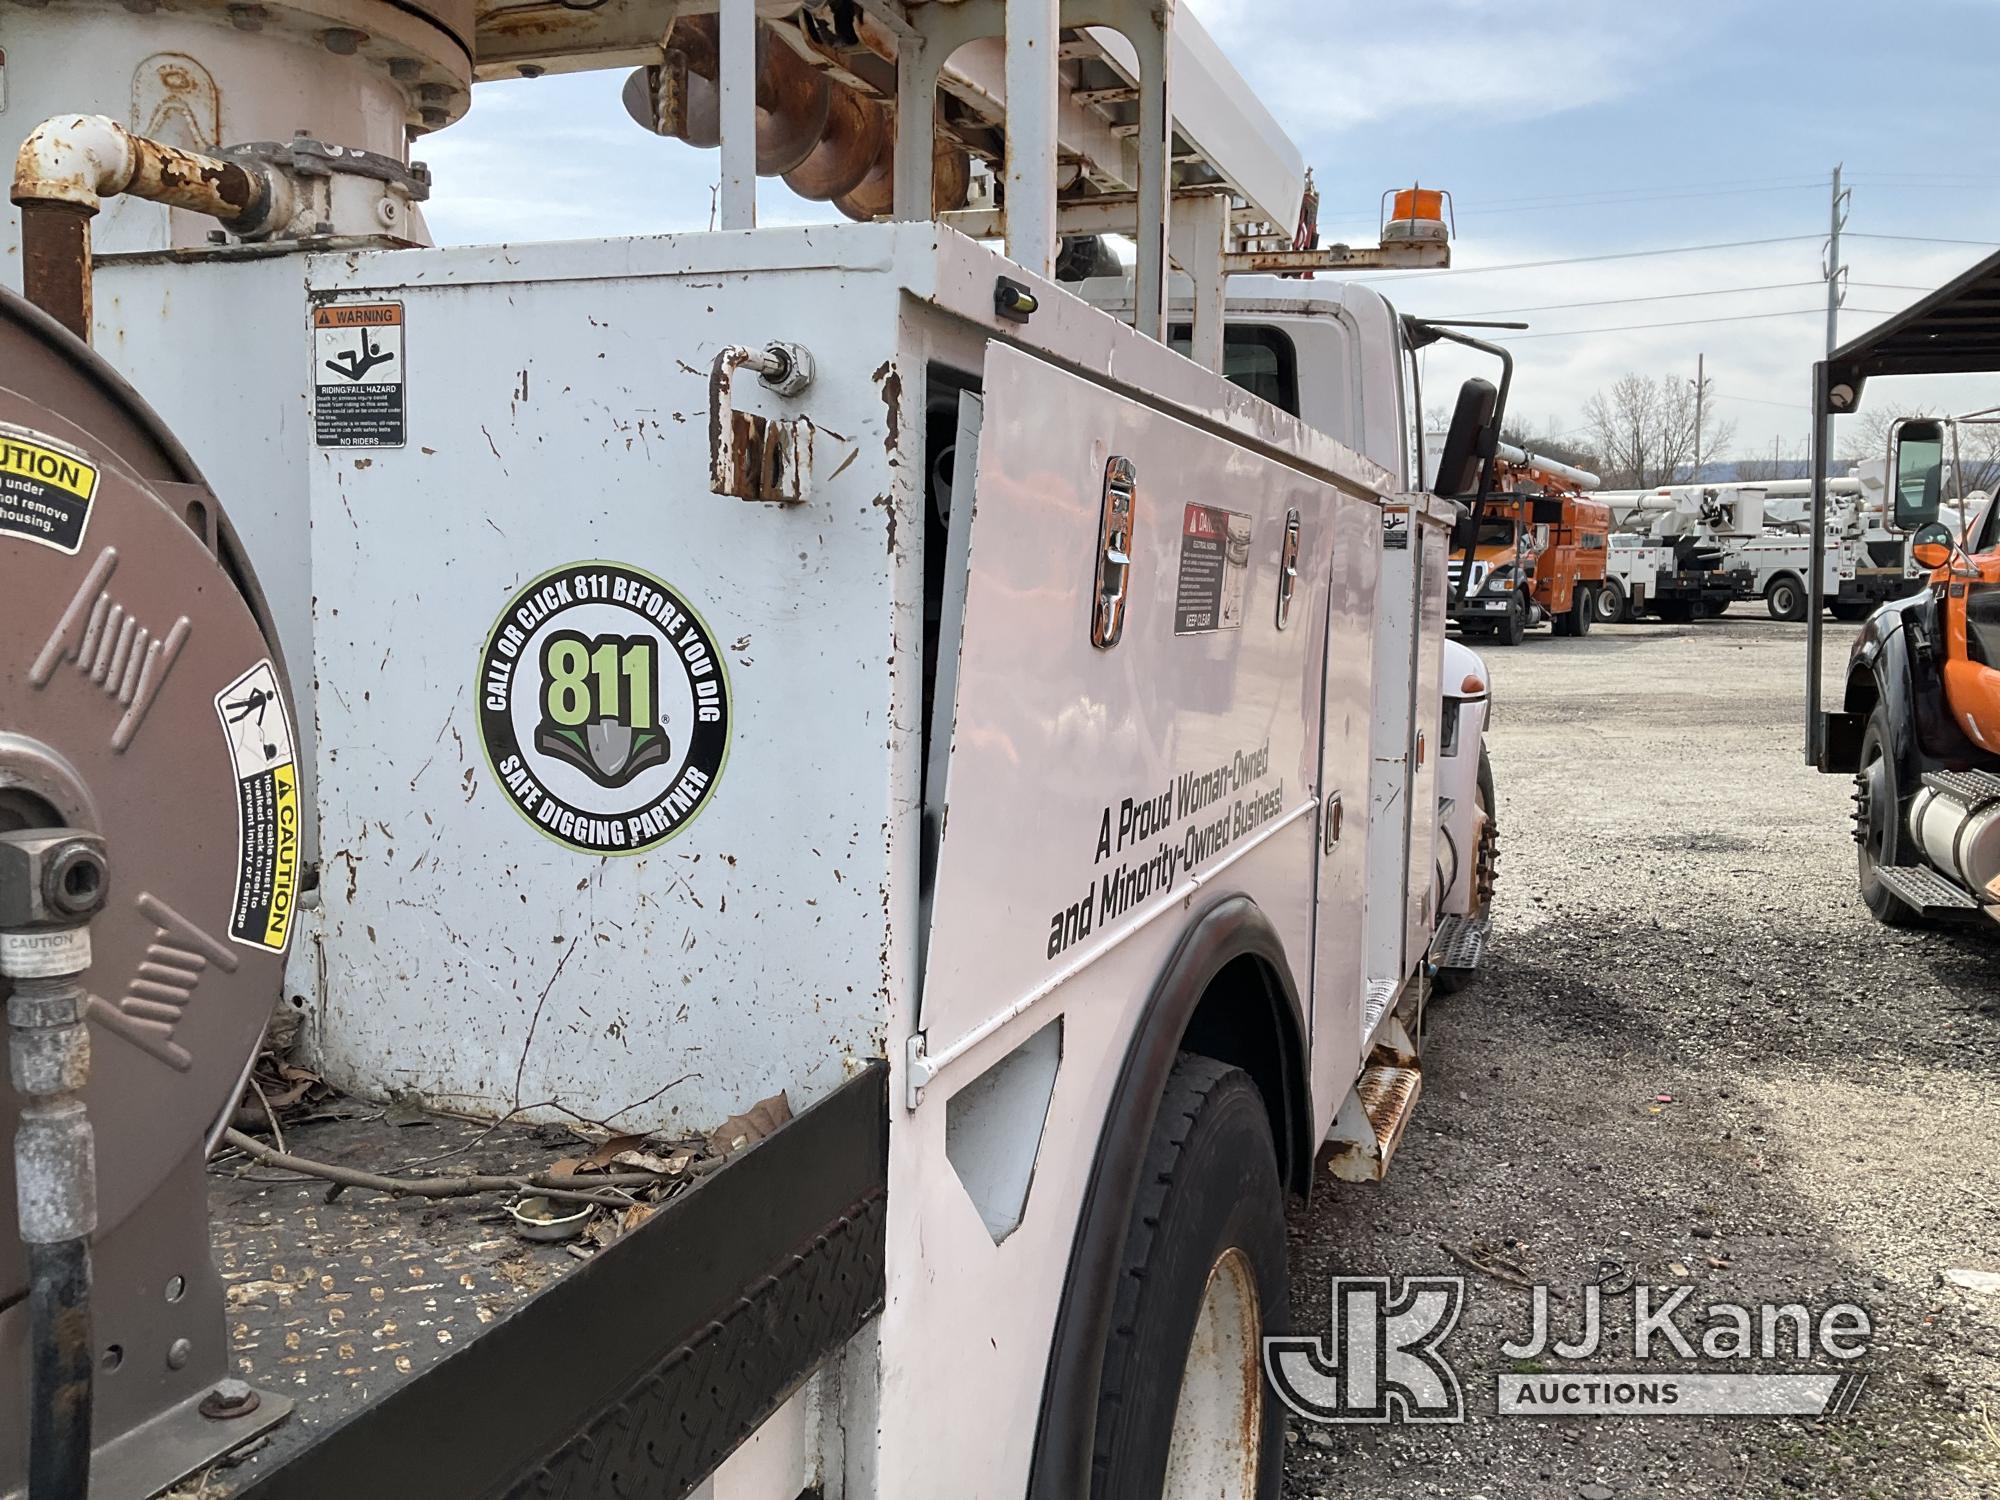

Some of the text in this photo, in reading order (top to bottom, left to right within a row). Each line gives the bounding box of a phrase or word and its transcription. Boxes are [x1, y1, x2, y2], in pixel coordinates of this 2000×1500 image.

[336, 309, 393, 324] WARNING
[6, 478, 44, 496] under
[22, 499, 69, 522] remove
[487, 575, 720, 722] CALL OR CLICK 811 BEFORE YOU DIG
[1186, 613, 1210, 627] KEEP CLEAR
[547, 639, 651, 728] 811
[238, 782, 256, 928] prevent injury or damage
[251, 779, 265, 908] walked back to reel to
[262, 775, 275, 906] Hose or cable must be
[499, 755, 710, 846] SAFE DIGGING PARTNER
[1094, 737, 1269, 865] A Proud Woman-Owned
[270, 805, 294, 933] CAUTION
[1047, 778, 1283, 960] and Minority-Owned Business!
[9, 934, 73, 949] CAUTION
